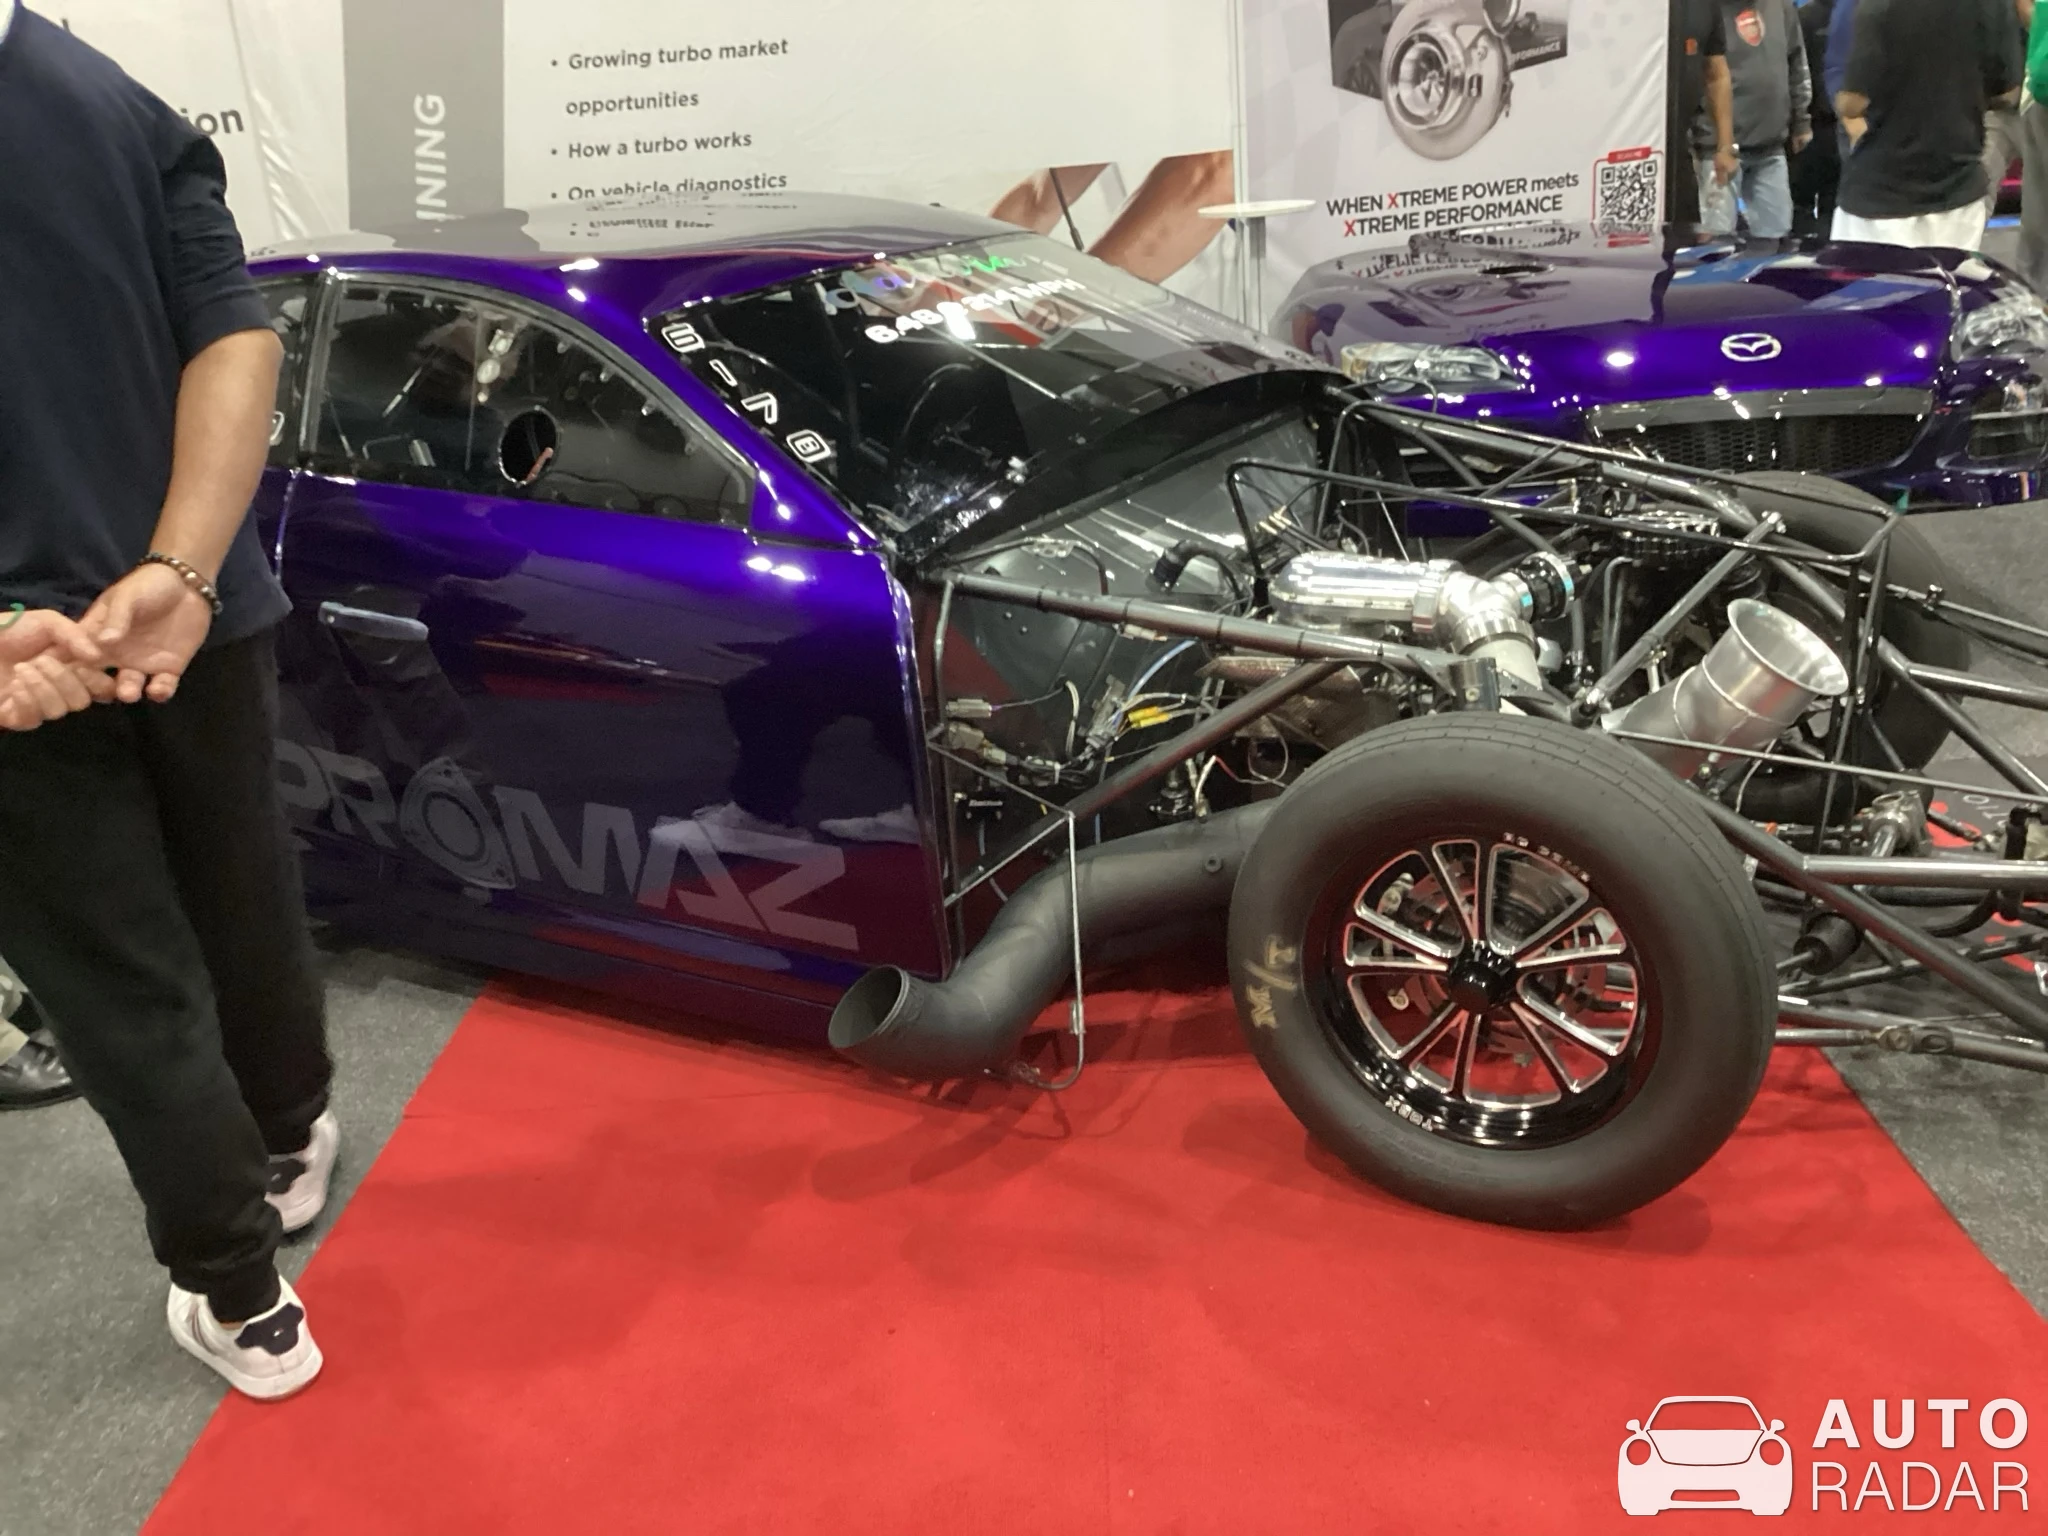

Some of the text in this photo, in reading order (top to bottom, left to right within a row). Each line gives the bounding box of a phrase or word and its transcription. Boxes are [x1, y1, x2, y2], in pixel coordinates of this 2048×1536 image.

[568, 38, 789, 69] Growing turbo market
[566, 91, 699, 116] opportunities
[568, 131, 752, 159] How a turbo works
[568, 186, 595, 201] On
[676, 173, 788, 195] diagnostics
[1326, 172, 1580, 216] WHEN XTREME POWER meets
[1343, 194, 1563, 238] XTREME PERFORMANCE
